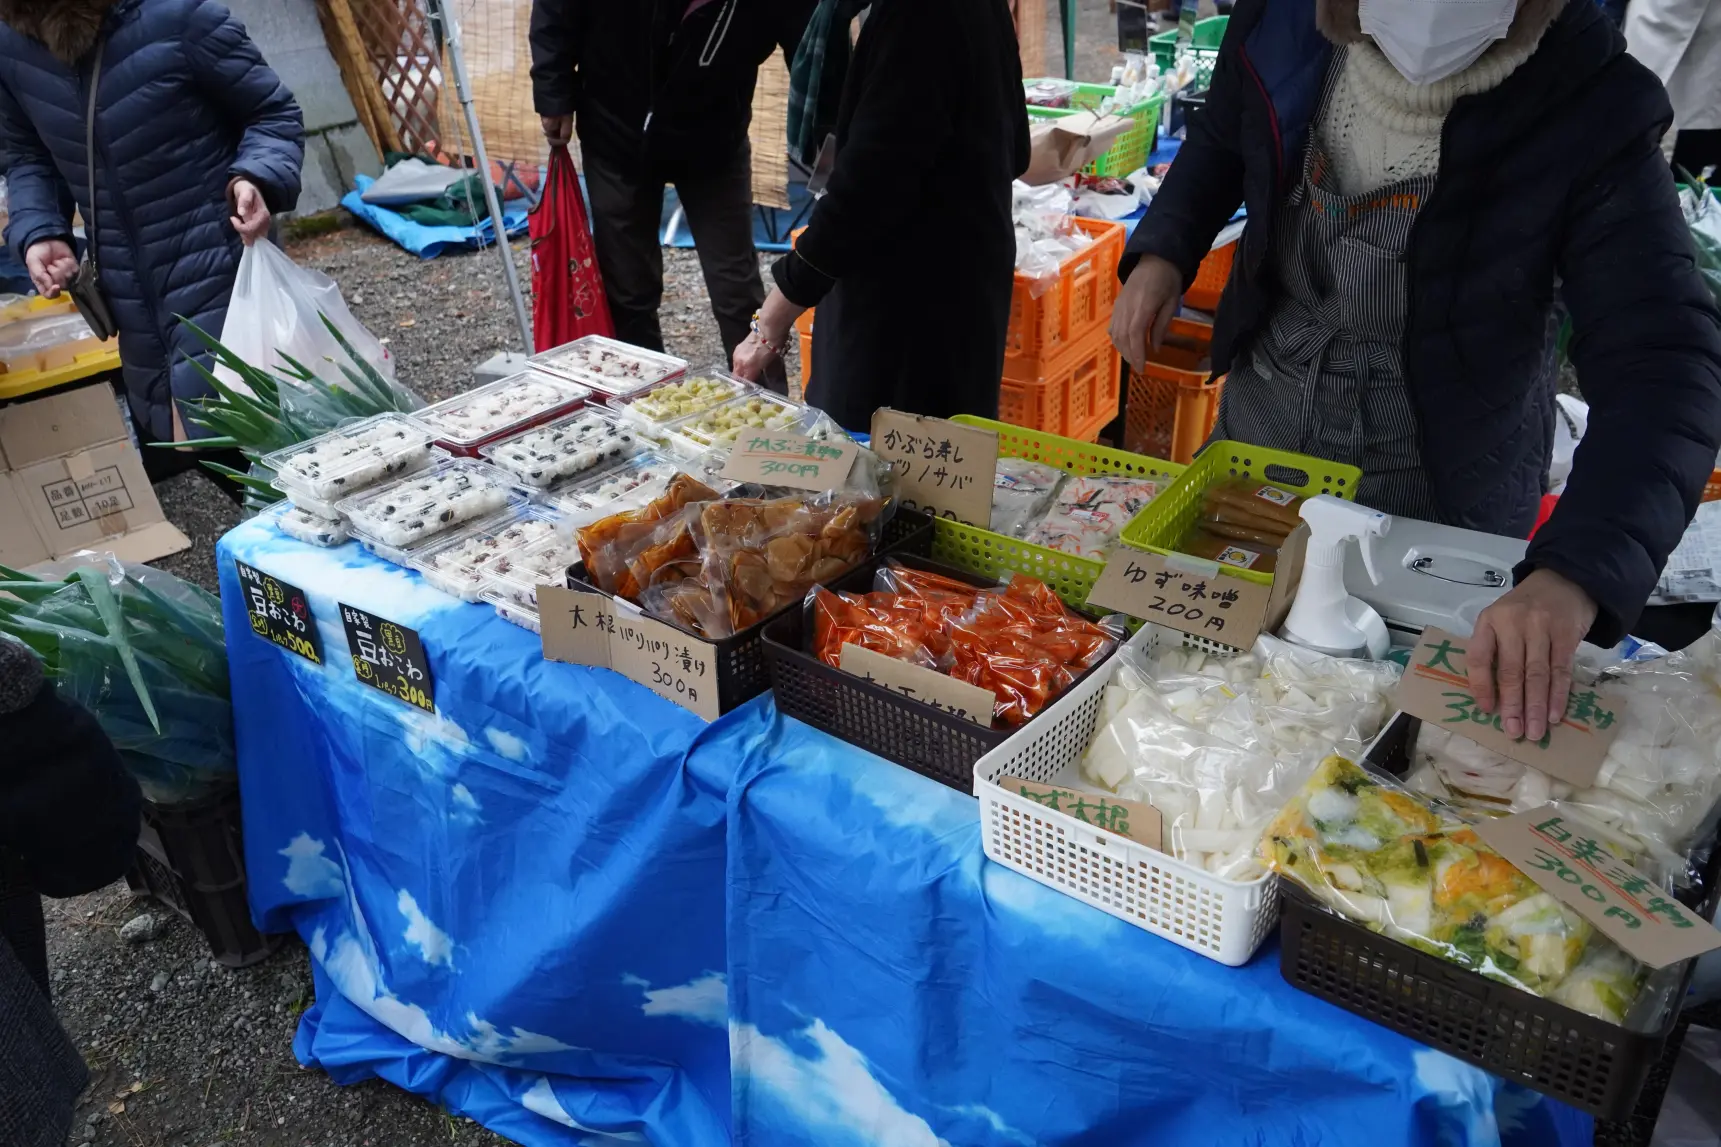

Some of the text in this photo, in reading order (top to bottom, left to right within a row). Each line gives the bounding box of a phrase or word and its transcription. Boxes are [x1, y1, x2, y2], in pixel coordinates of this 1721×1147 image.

[760, 460, 819, 478] 300円
[240, 565, 263, 586] 自家製
[1123, 561, 1239, 609] ゆず味噌
[250, 586, 305, 633] 豆おこわ
[345, 608, 372, 629] 自家製
[1148, 596, 1225, 632] 200円
[356, 630, 423, 680] 豆おこわ
[652, 662, 697, 702] 300円
[1525, 847, 1641, 929] 300円
